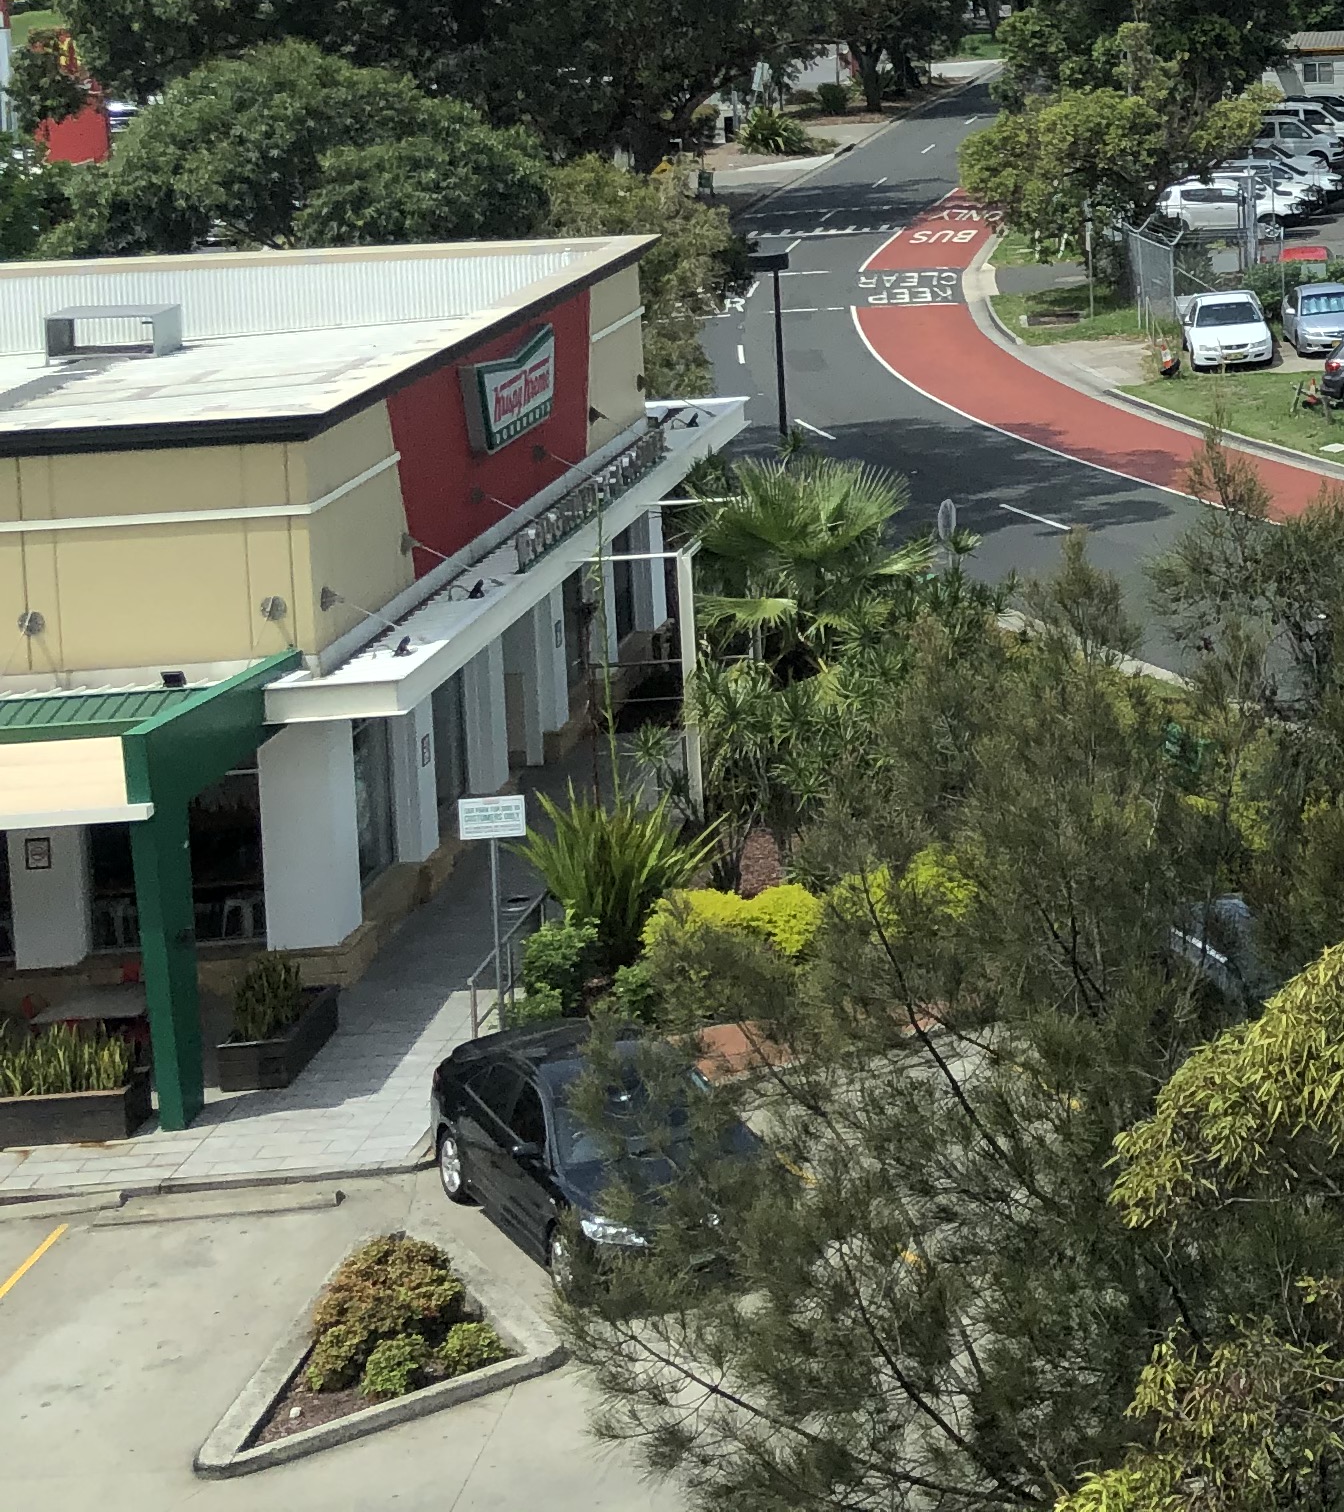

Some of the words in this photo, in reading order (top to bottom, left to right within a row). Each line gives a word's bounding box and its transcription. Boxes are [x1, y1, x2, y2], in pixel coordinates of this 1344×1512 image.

[909, 229, 979, 244] BUS
[858, 272, 957, 288] CLEAR
[868, 287, 953, 303] KEEP
